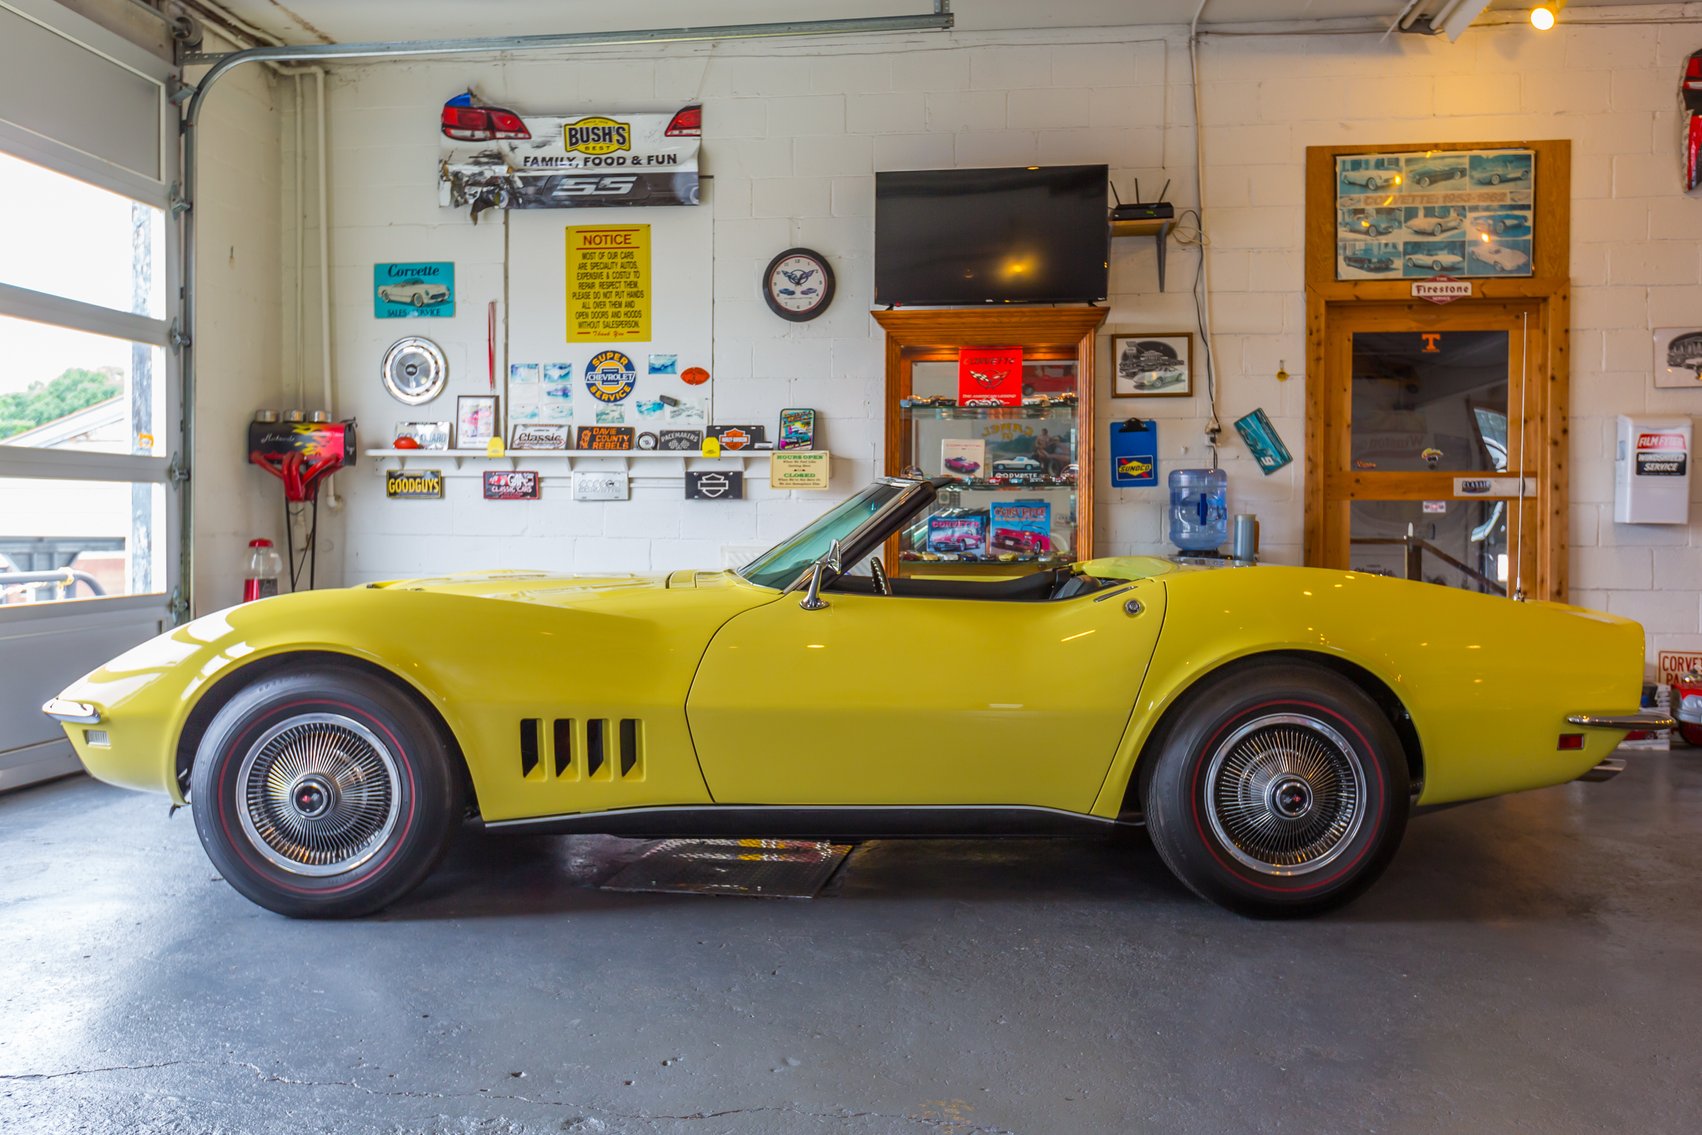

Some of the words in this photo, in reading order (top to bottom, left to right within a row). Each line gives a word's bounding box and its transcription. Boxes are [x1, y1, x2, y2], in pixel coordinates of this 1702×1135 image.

[568, 126, 627, 147] BUSH'S
[523, 156, 579, 168] FAMILY,
[583, 156, 626, 166] FOOD
[631, 155, 642, 165] &
[647, 153, 677, 165] FUN
[583, 234, 632, 246] NOTICE
[620, 251, 634, 259] CARS
[388, 264, 440, 278] Corvette
[1416, 285, 1469, 294] Firestone
[1422, 334, 1440, 352] T
[592, 352, 628, 367] SUPER
[588, 373, 632, 381] CHEVROLET
[590, 385, 631, 401] SERVICE
[518, 432, 562, 442] Classic
[596, 434, 630, 442] COUNTY
[660, 432, 699, 442] PACEMAKERS
[1639, 436, 1659, 448] FILM
[592, 442, 630, 450] REBELS
[1120, 464, 1151, 472] SUNOCO
[1644, 462, 1679, 472] SERVICE
[388, 478, 439, 493] GOODGUYS
